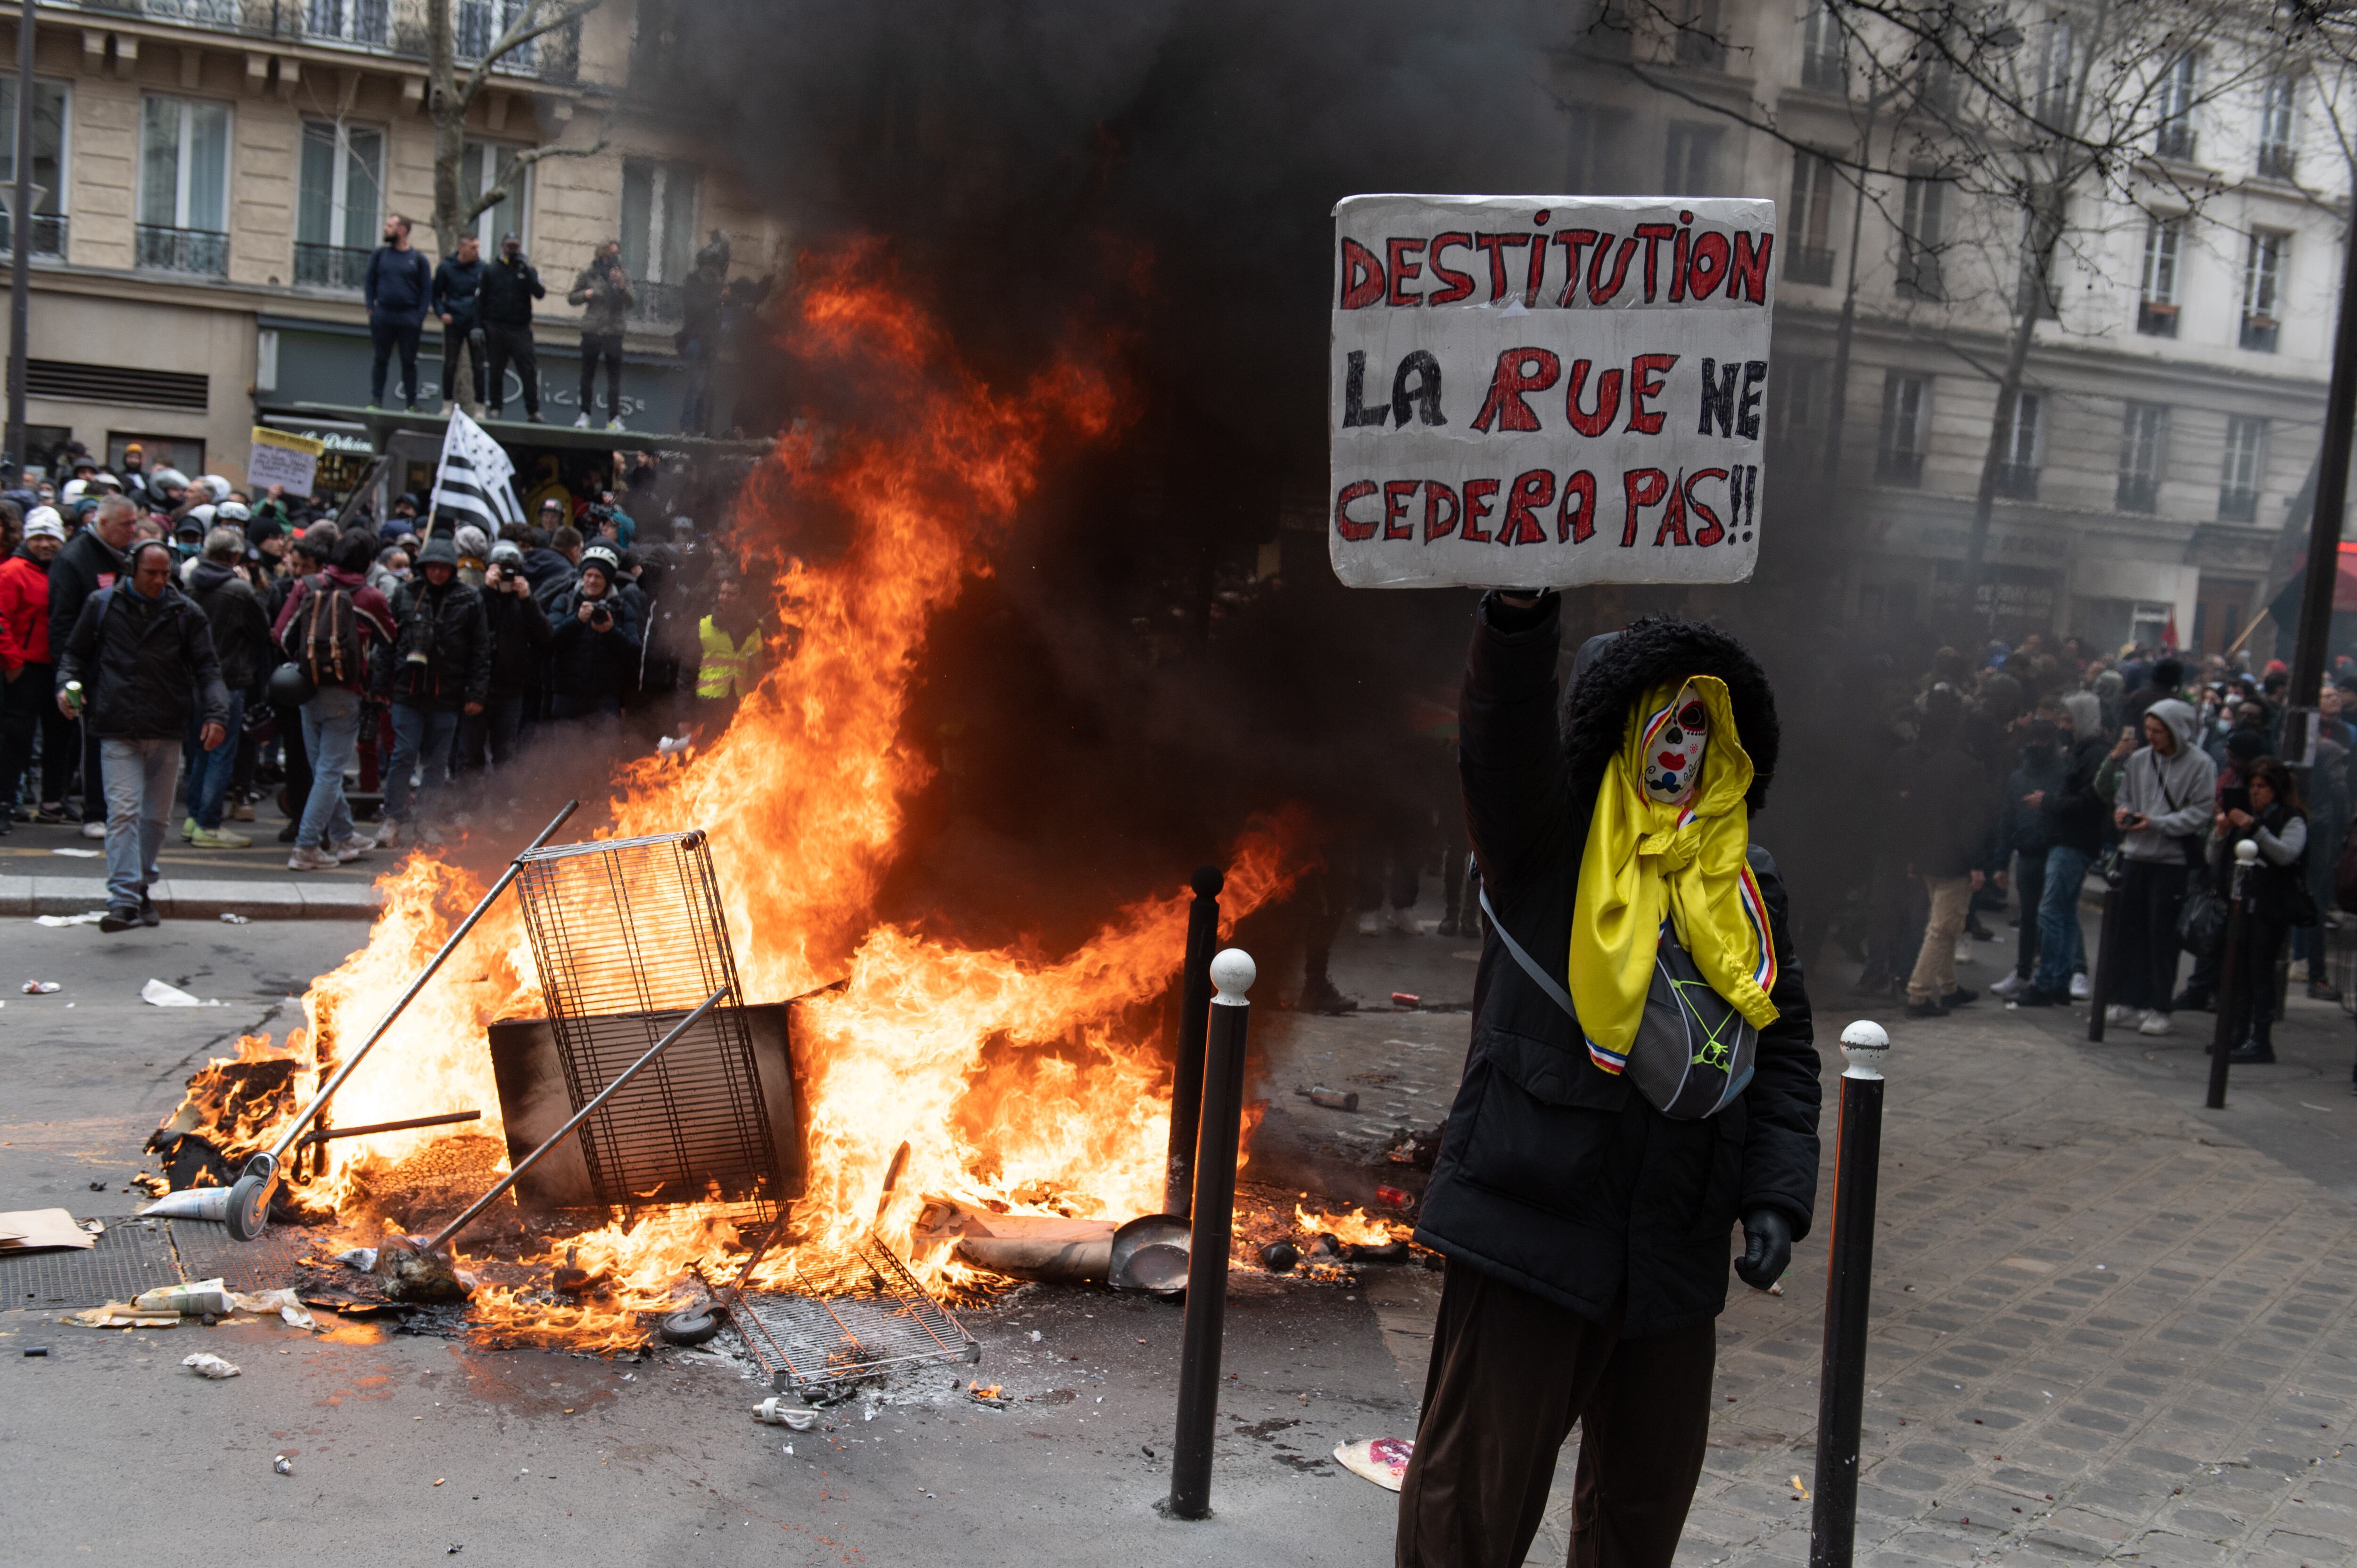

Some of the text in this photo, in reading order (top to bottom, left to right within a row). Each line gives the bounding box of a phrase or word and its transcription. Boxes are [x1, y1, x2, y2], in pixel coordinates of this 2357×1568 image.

[1342, 347, 1768, 440] LA RUE NE
[1335, 468, 1597, 546] CEDERA
